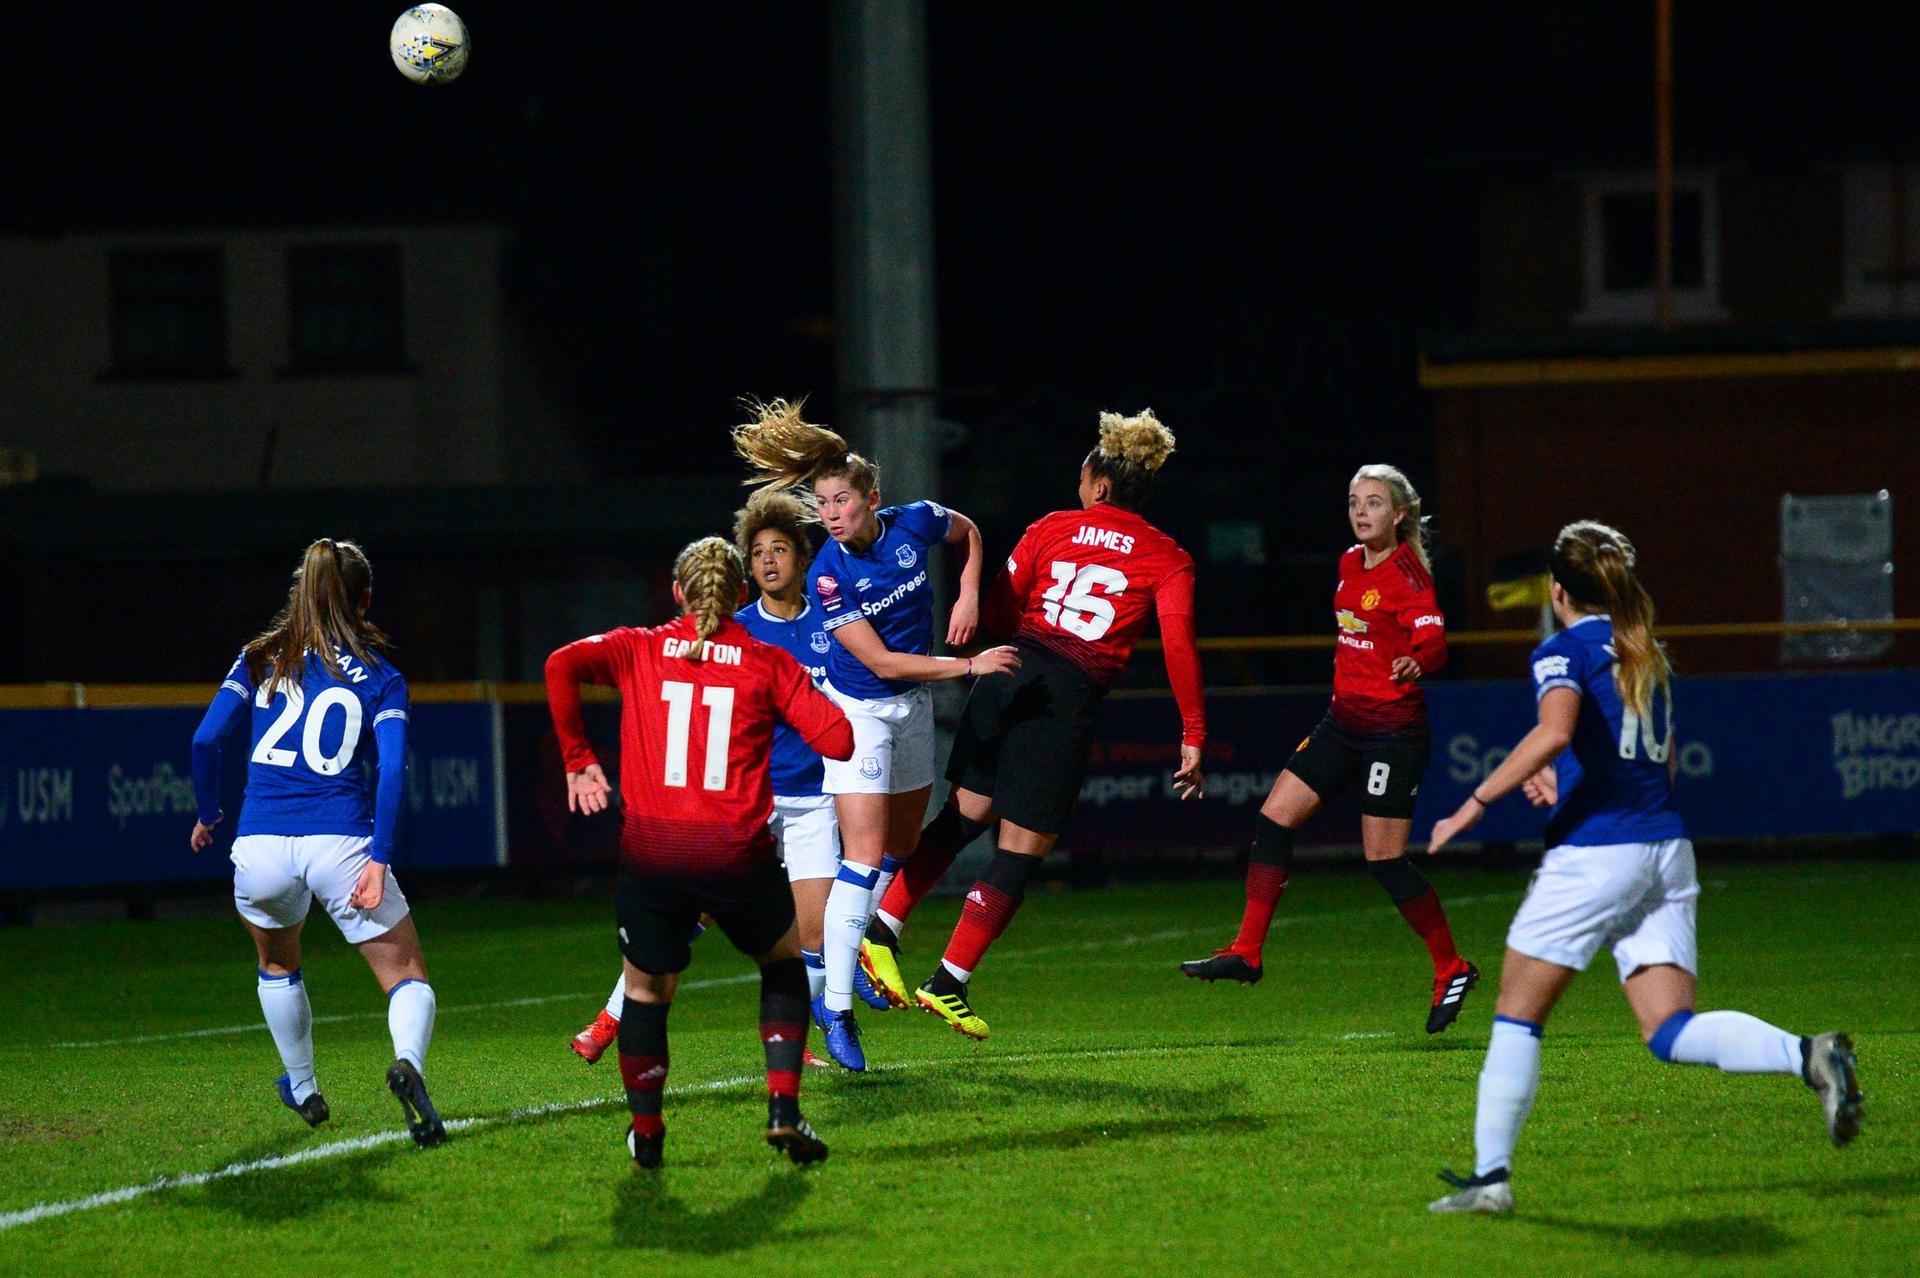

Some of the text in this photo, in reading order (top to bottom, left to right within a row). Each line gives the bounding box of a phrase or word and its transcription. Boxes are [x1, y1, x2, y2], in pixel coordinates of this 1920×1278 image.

[1072, 525, 1135, 554] JAMES
[1041, 560, 1129, 641] 16
[251, 676, 363, 776] 20
[661, 680, 735, 791] 11
[17, 767, 74, 823] USM
[1367, 761, 1391, 796] 8
